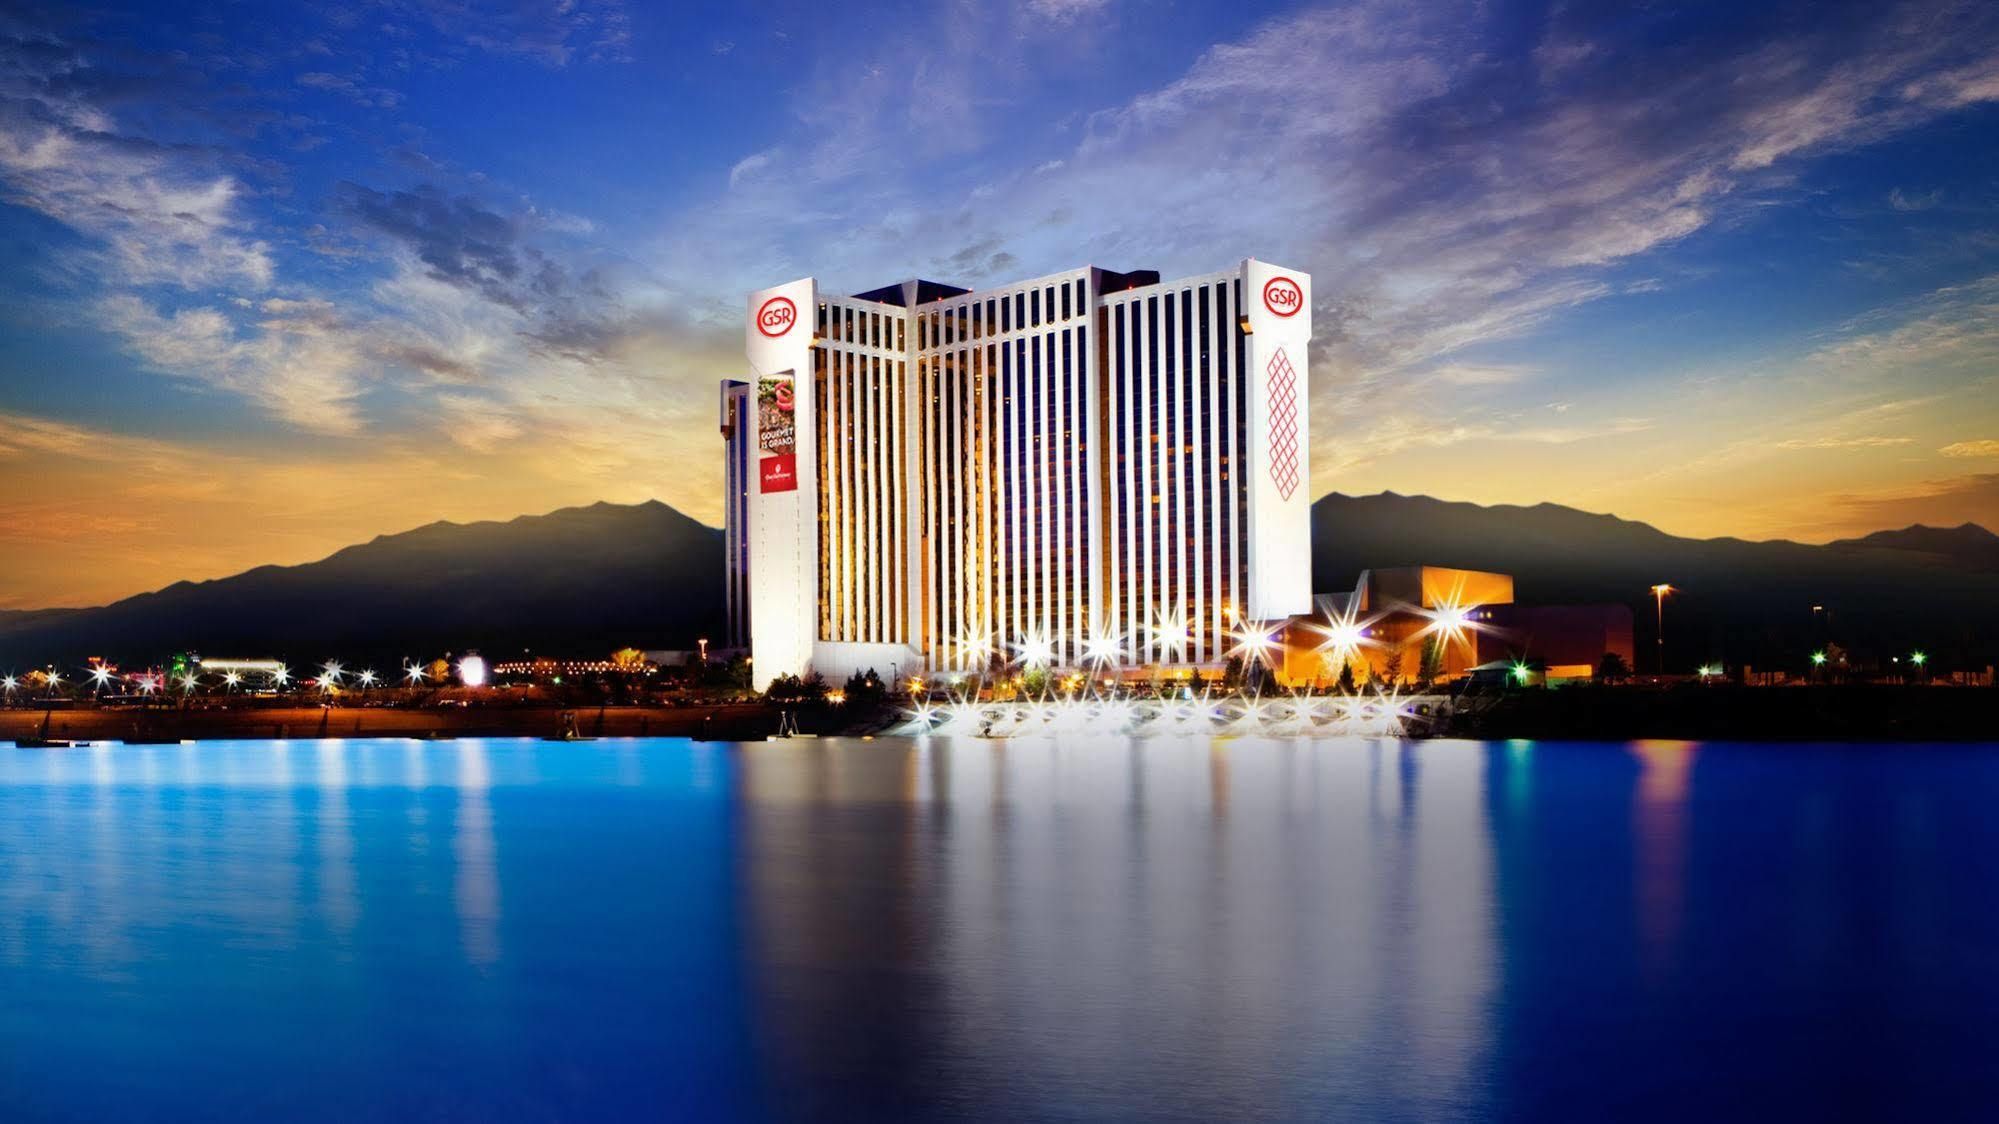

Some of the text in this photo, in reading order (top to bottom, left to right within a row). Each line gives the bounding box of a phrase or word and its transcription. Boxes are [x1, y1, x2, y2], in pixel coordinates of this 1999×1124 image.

[1268, 287, 1297, 307] GSR
[762, 307, 791, 327] GSR
[761, 427, 794, 441] GOURMET
